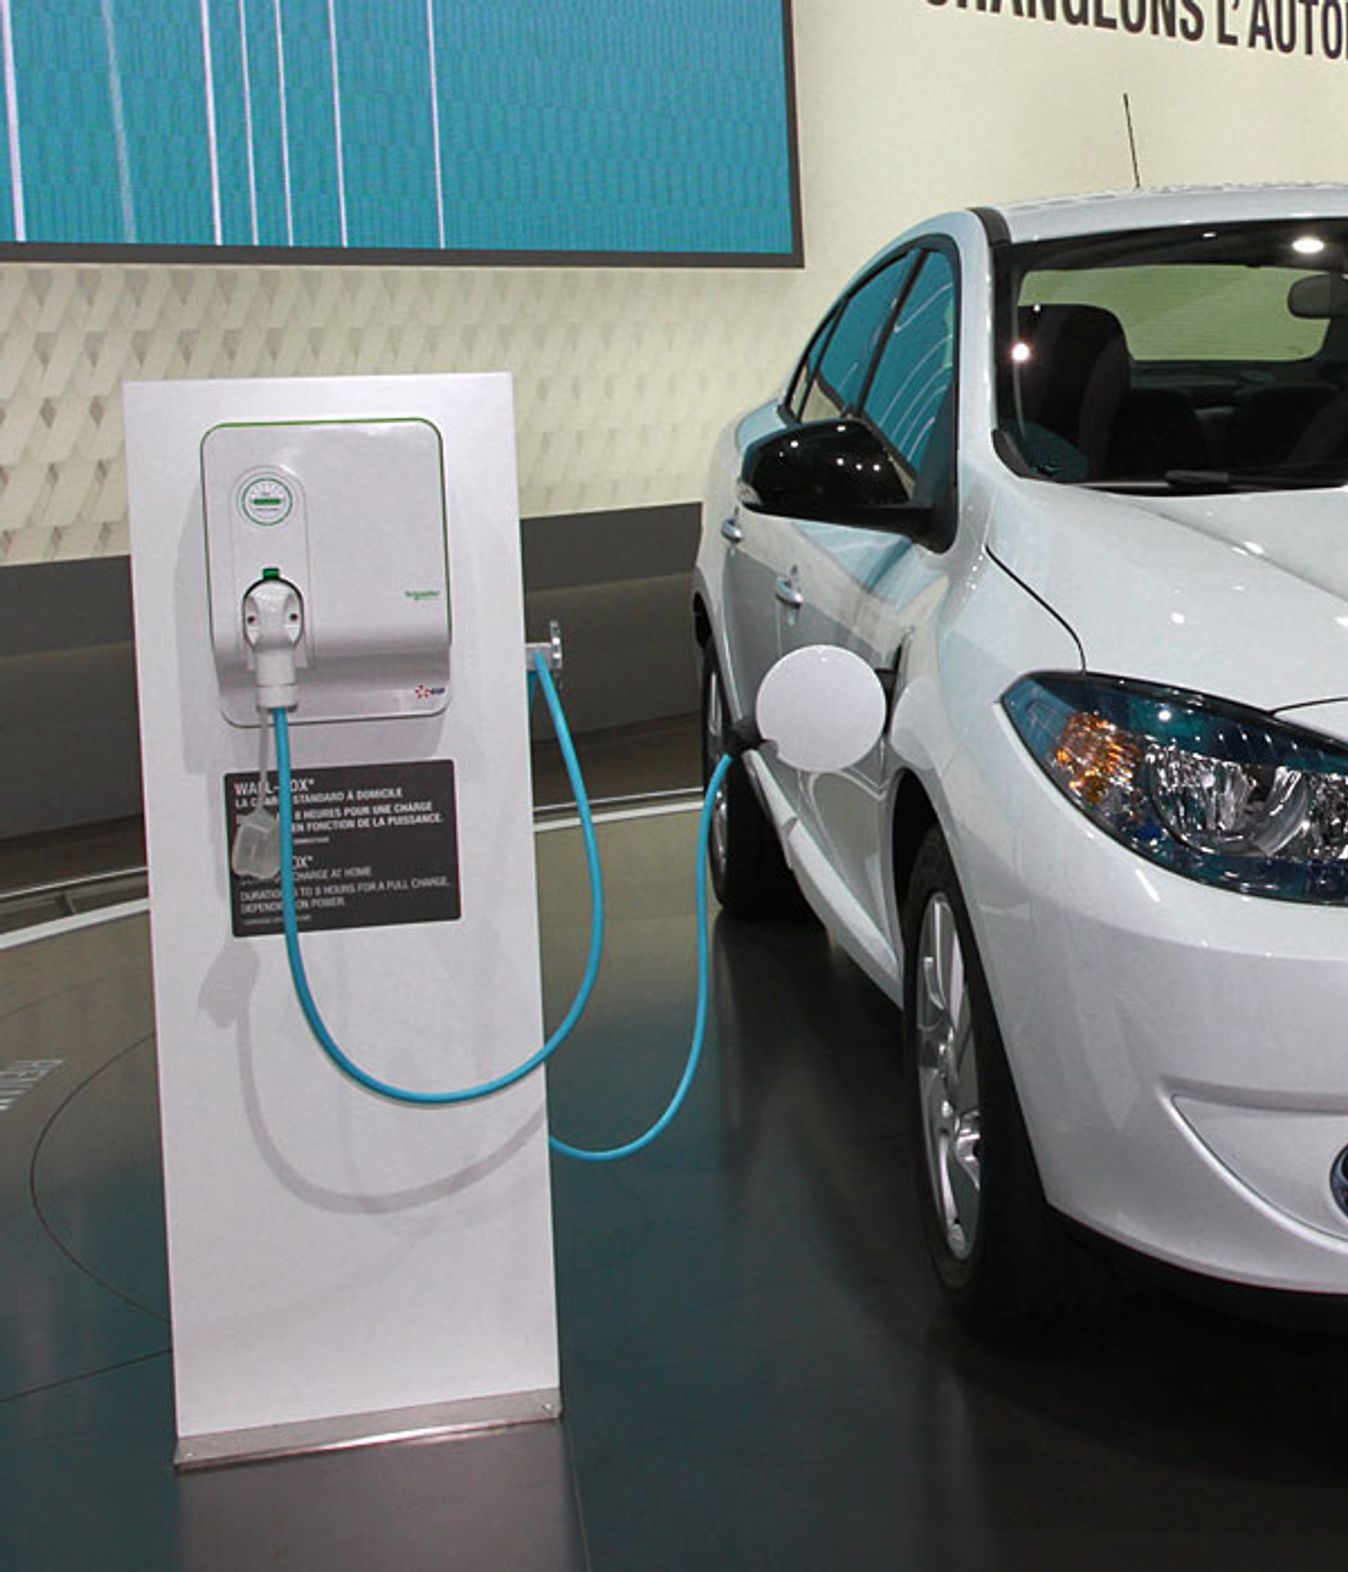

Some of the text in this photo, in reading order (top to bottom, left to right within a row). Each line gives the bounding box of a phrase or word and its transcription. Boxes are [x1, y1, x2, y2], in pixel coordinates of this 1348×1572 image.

[926, 0, 1205, 41] GEONS
[356, 787, 402, 800] DOMICILE
[393, 801, 432, 813] CHARGE
